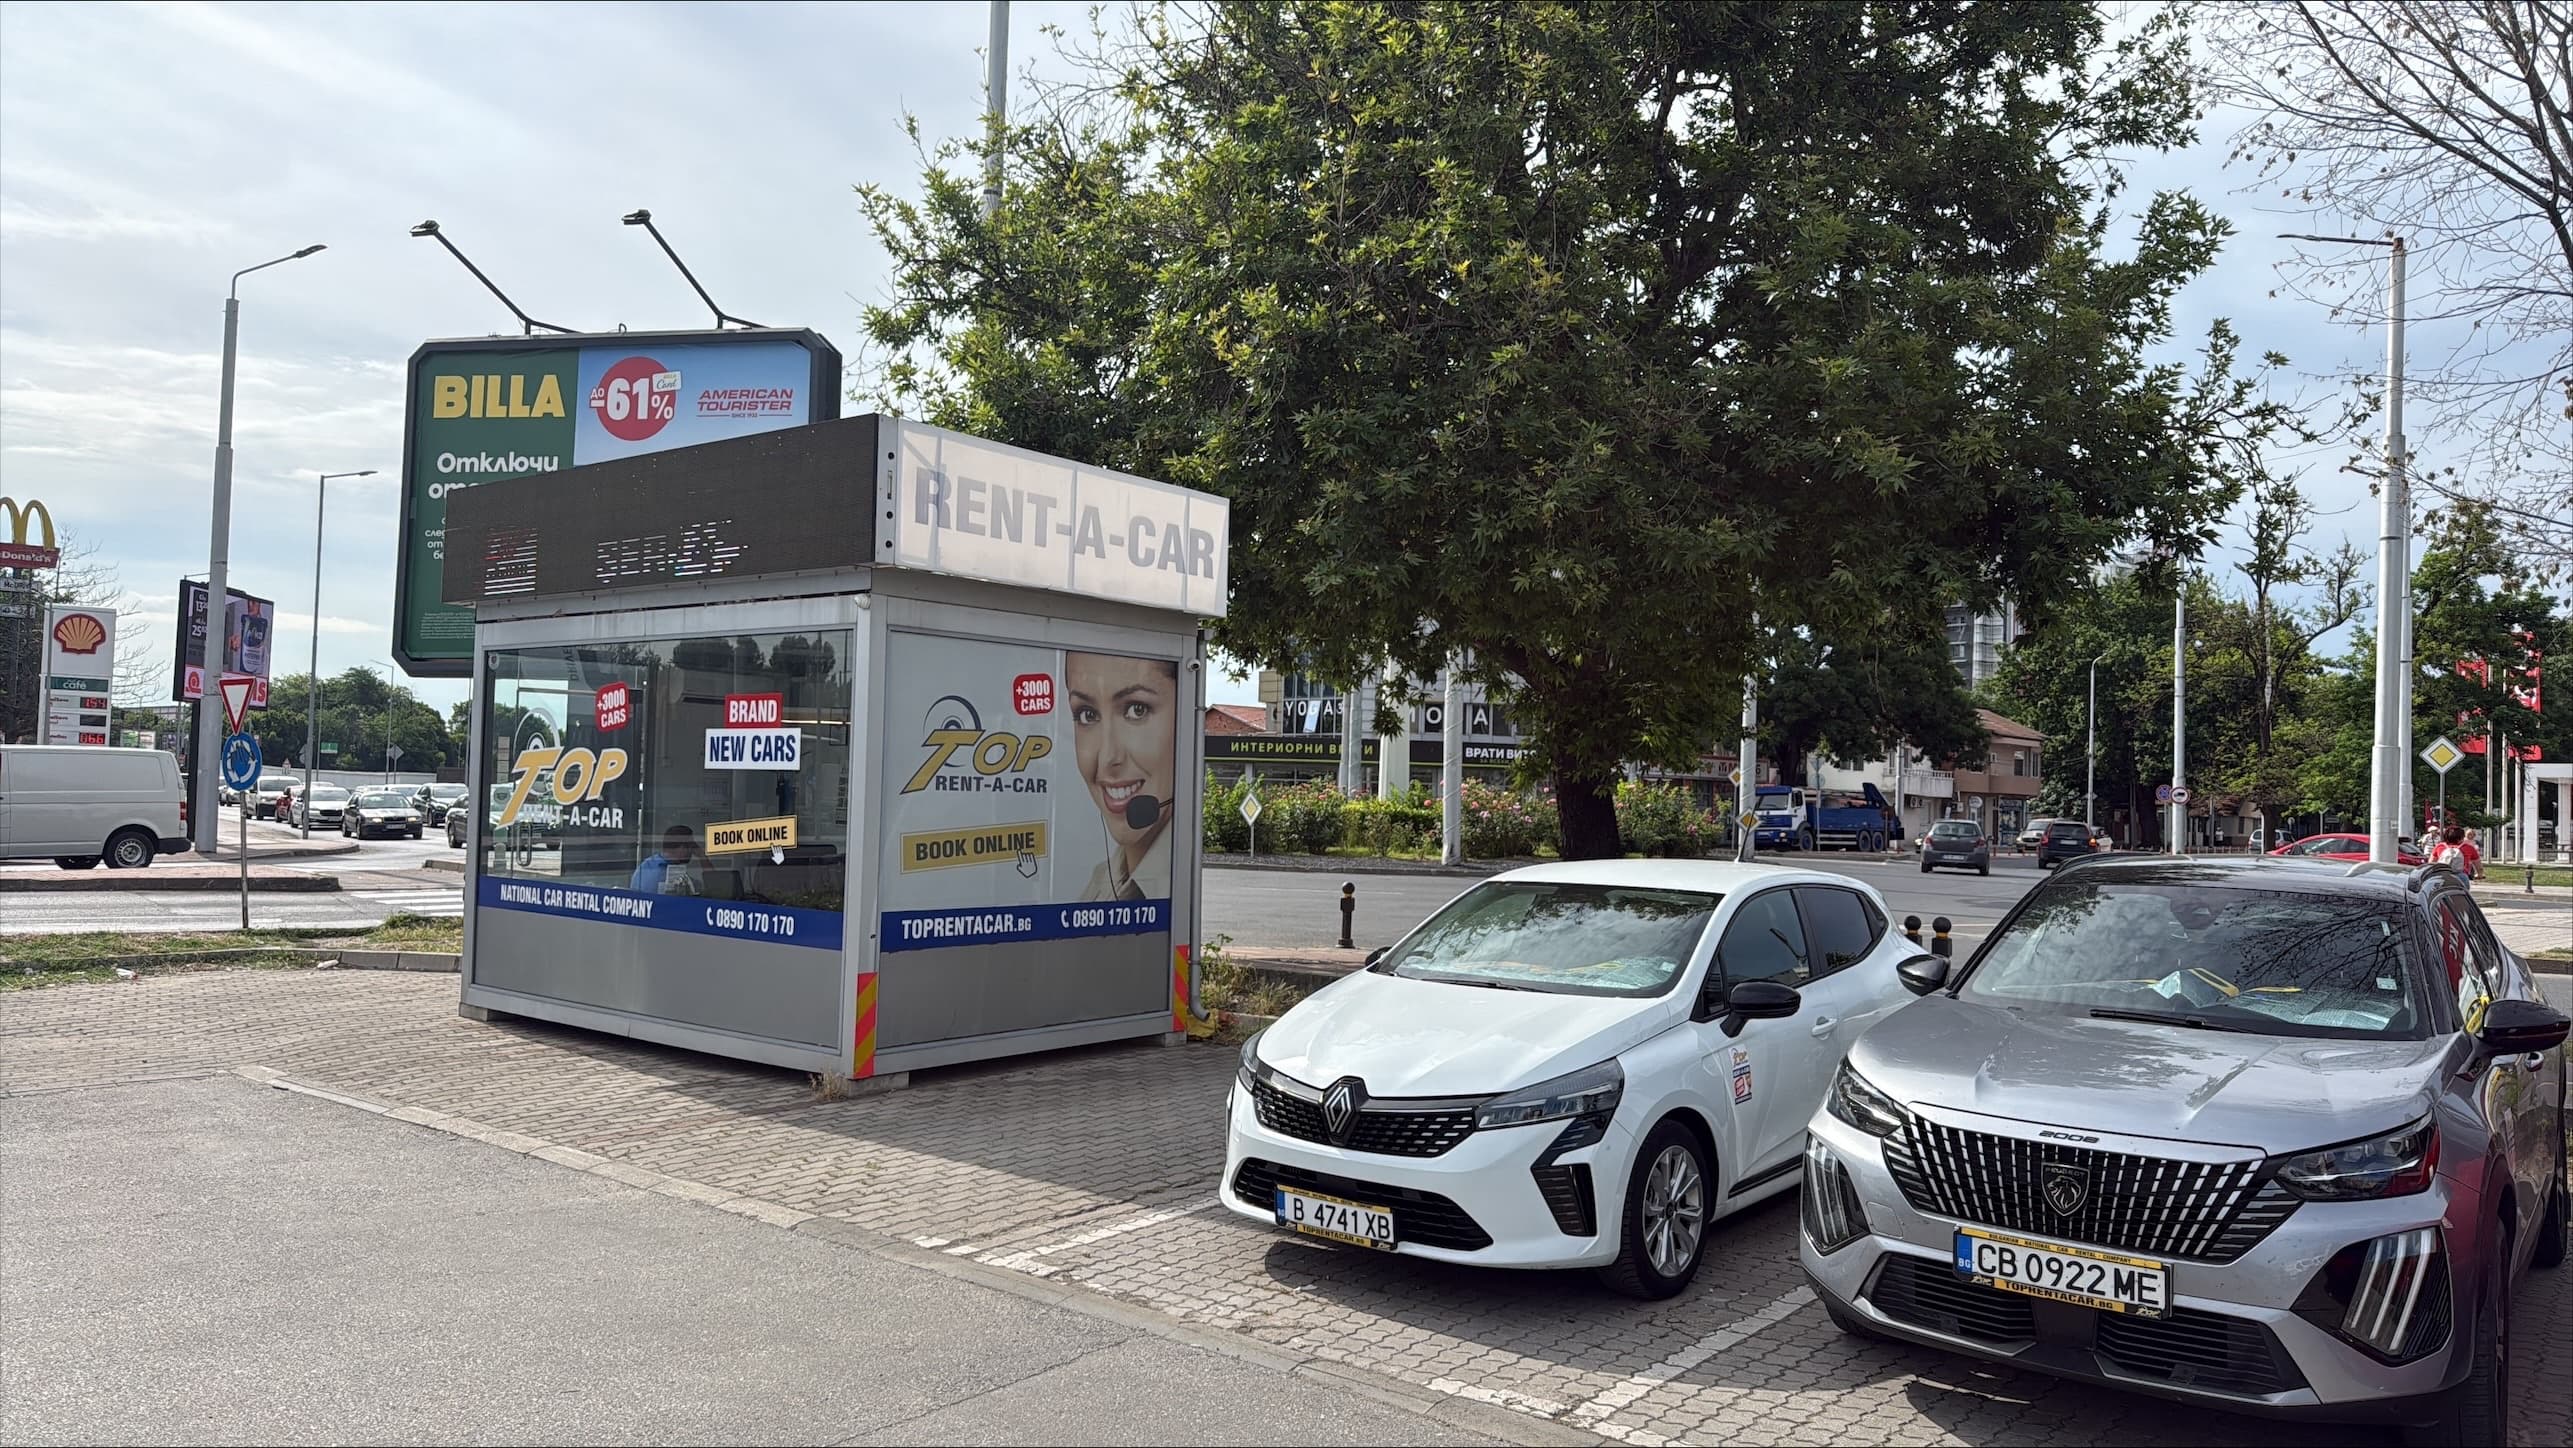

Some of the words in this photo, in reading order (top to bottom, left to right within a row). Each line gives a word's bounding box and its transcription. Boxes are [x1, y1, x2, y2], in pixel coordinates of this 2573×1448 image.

[433, 374, 566, 418] BILLA
[656, 379, 677, 390] Card
[700, 389, 793, 400] AMERICAN
[697, 400, 791, 411] TOURISTER
[437, 451, 559, 473] Отключи
[914, 465, 1214, 579] RENT-A-CAR
[0, 551, 51, 563] Donald's
[597, 687, 626, 710] +3000
[1015, 680, 1050, 697] +3000
[729, 700, 777, 723] BRAND
[1020, 698, 1051, 711] CARS
[601, 708, 626, 728] CARS
[709, 736, 746, 762] NEW
[751, 735, 796, 762] CARS
[1231, 741, 1324, 754] ИНТЕРИОРНИ
[1464, 747, 1505, 759] ВРАТИ
[900, 729, 1053, 795] TOP
[495, 747, 628, 829] TOP
[935, 775, 1047, 793] RENT-A-CAR
[523, 804, 623, 829] RENT-A-CAR
[713, 829, 744, 846] BOOK
[747, 825, 788, 843] ONLINE
[915, 838, 967, 862] BOOK
[973, 831, 1035, 855] ONLINE
[500, 884, 542, 905] NATIONAL
[543, 888, 563, 908] CAR
[565, 891, 601, 912] RENTAL
[603, 895, 654, 919] COMPANY
[716, 908, 745, 930] 0890
[747, 912, 769, 933] 170
[772, 915, 795, 936] 170
[902, 913, 1032, 940] TOPRENTACAR.BG
[1073, 908, 1102, 928] 0890
[1108, 907, 1130, 926] 170
[1134, 905, 1156, 924] 170
[2039, 1130, 2100, 1144] 2008
[1293, 1197, 1305, 1221] B
[1314, 1203, 1360, 1234] 4741
[1365, 1211, 1391, 1240] XB
[1958, 1258, 1971, 1268] BG
[1977, 1243, 2018, 1279] CB
[2025, 1253, 2106, 1297] 0922
[2113, 1267, 2160, 1305] ME
[2003, 1281, 2113, 1310] TOPRENTACAR.BG
